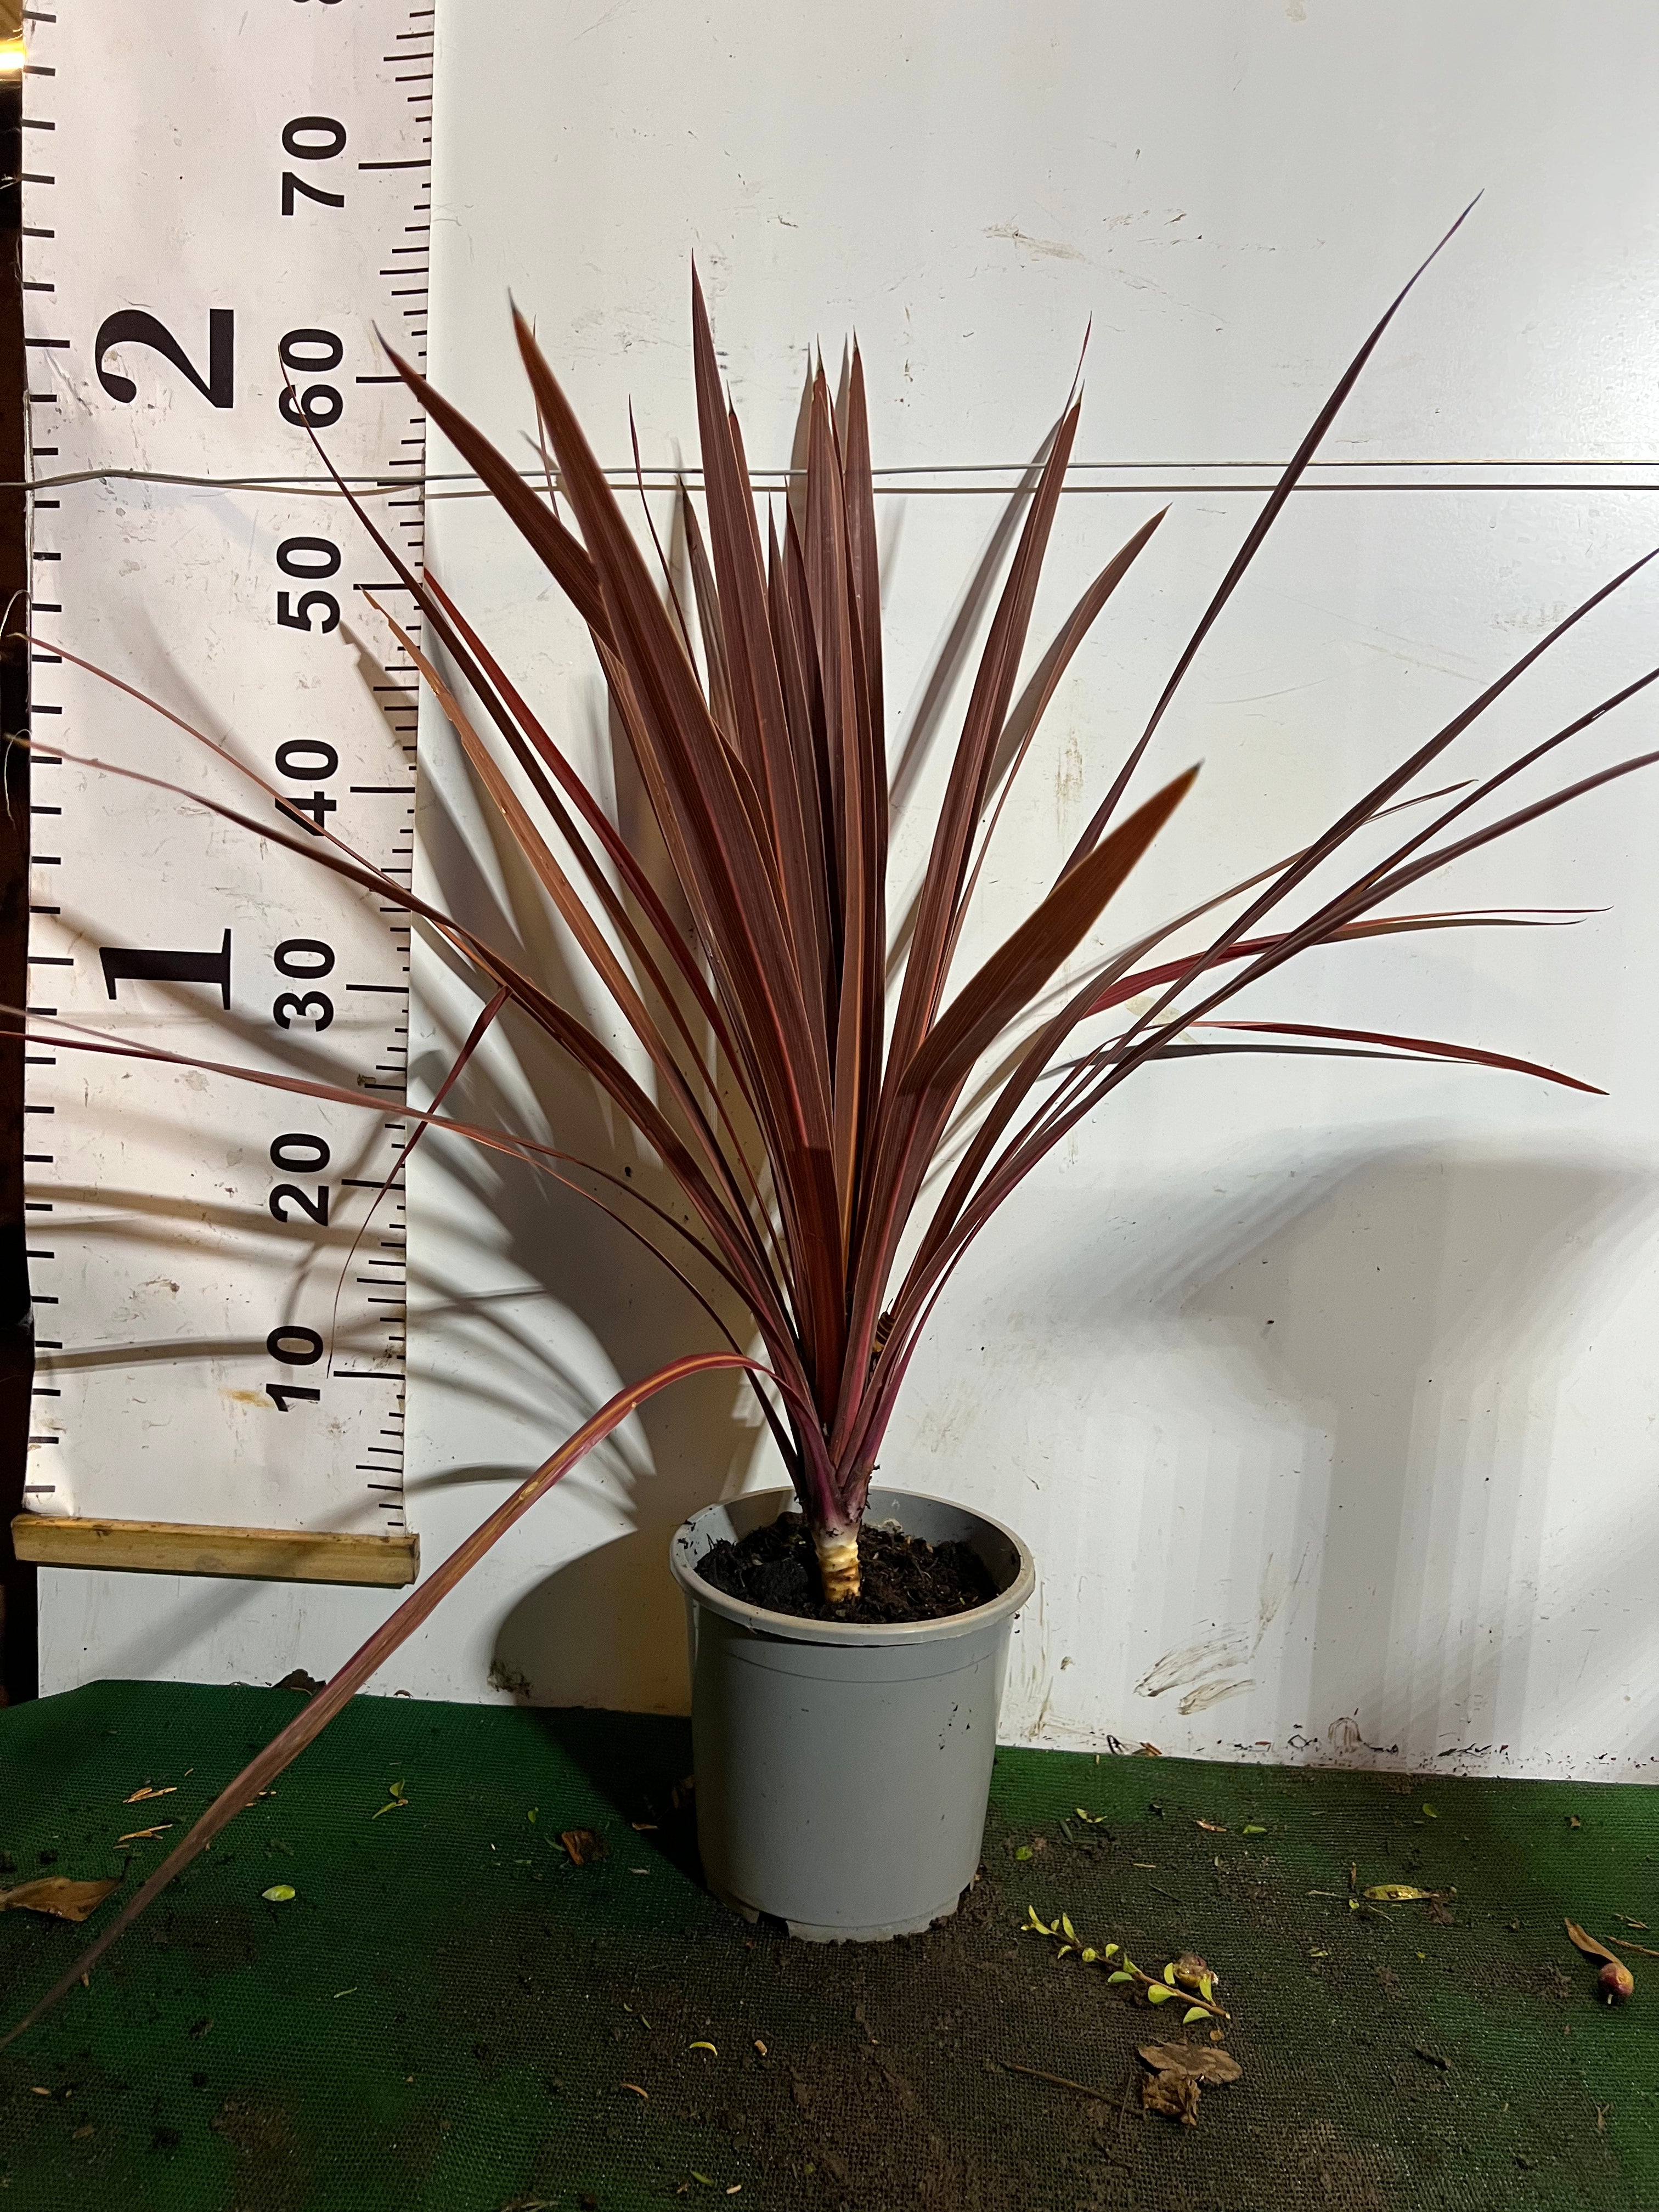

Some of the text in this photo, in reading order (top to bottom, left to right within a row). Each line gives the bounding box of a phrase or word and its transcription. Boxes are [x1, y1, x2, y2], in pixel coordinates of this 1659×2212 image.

[281, 116, 347, 216] 70
[95, 308, 234, 409] 2
[279, 329, 343, 428] 60
[276, 537, 341, 634] 50
[275, 740, 338, 837] 40
[99, 928, 231, 1010] 1
[273, 939, 335, 1032] 30
[269, 1133, 330, 1227] 20
[266, 1325, 324, 1412] 10
